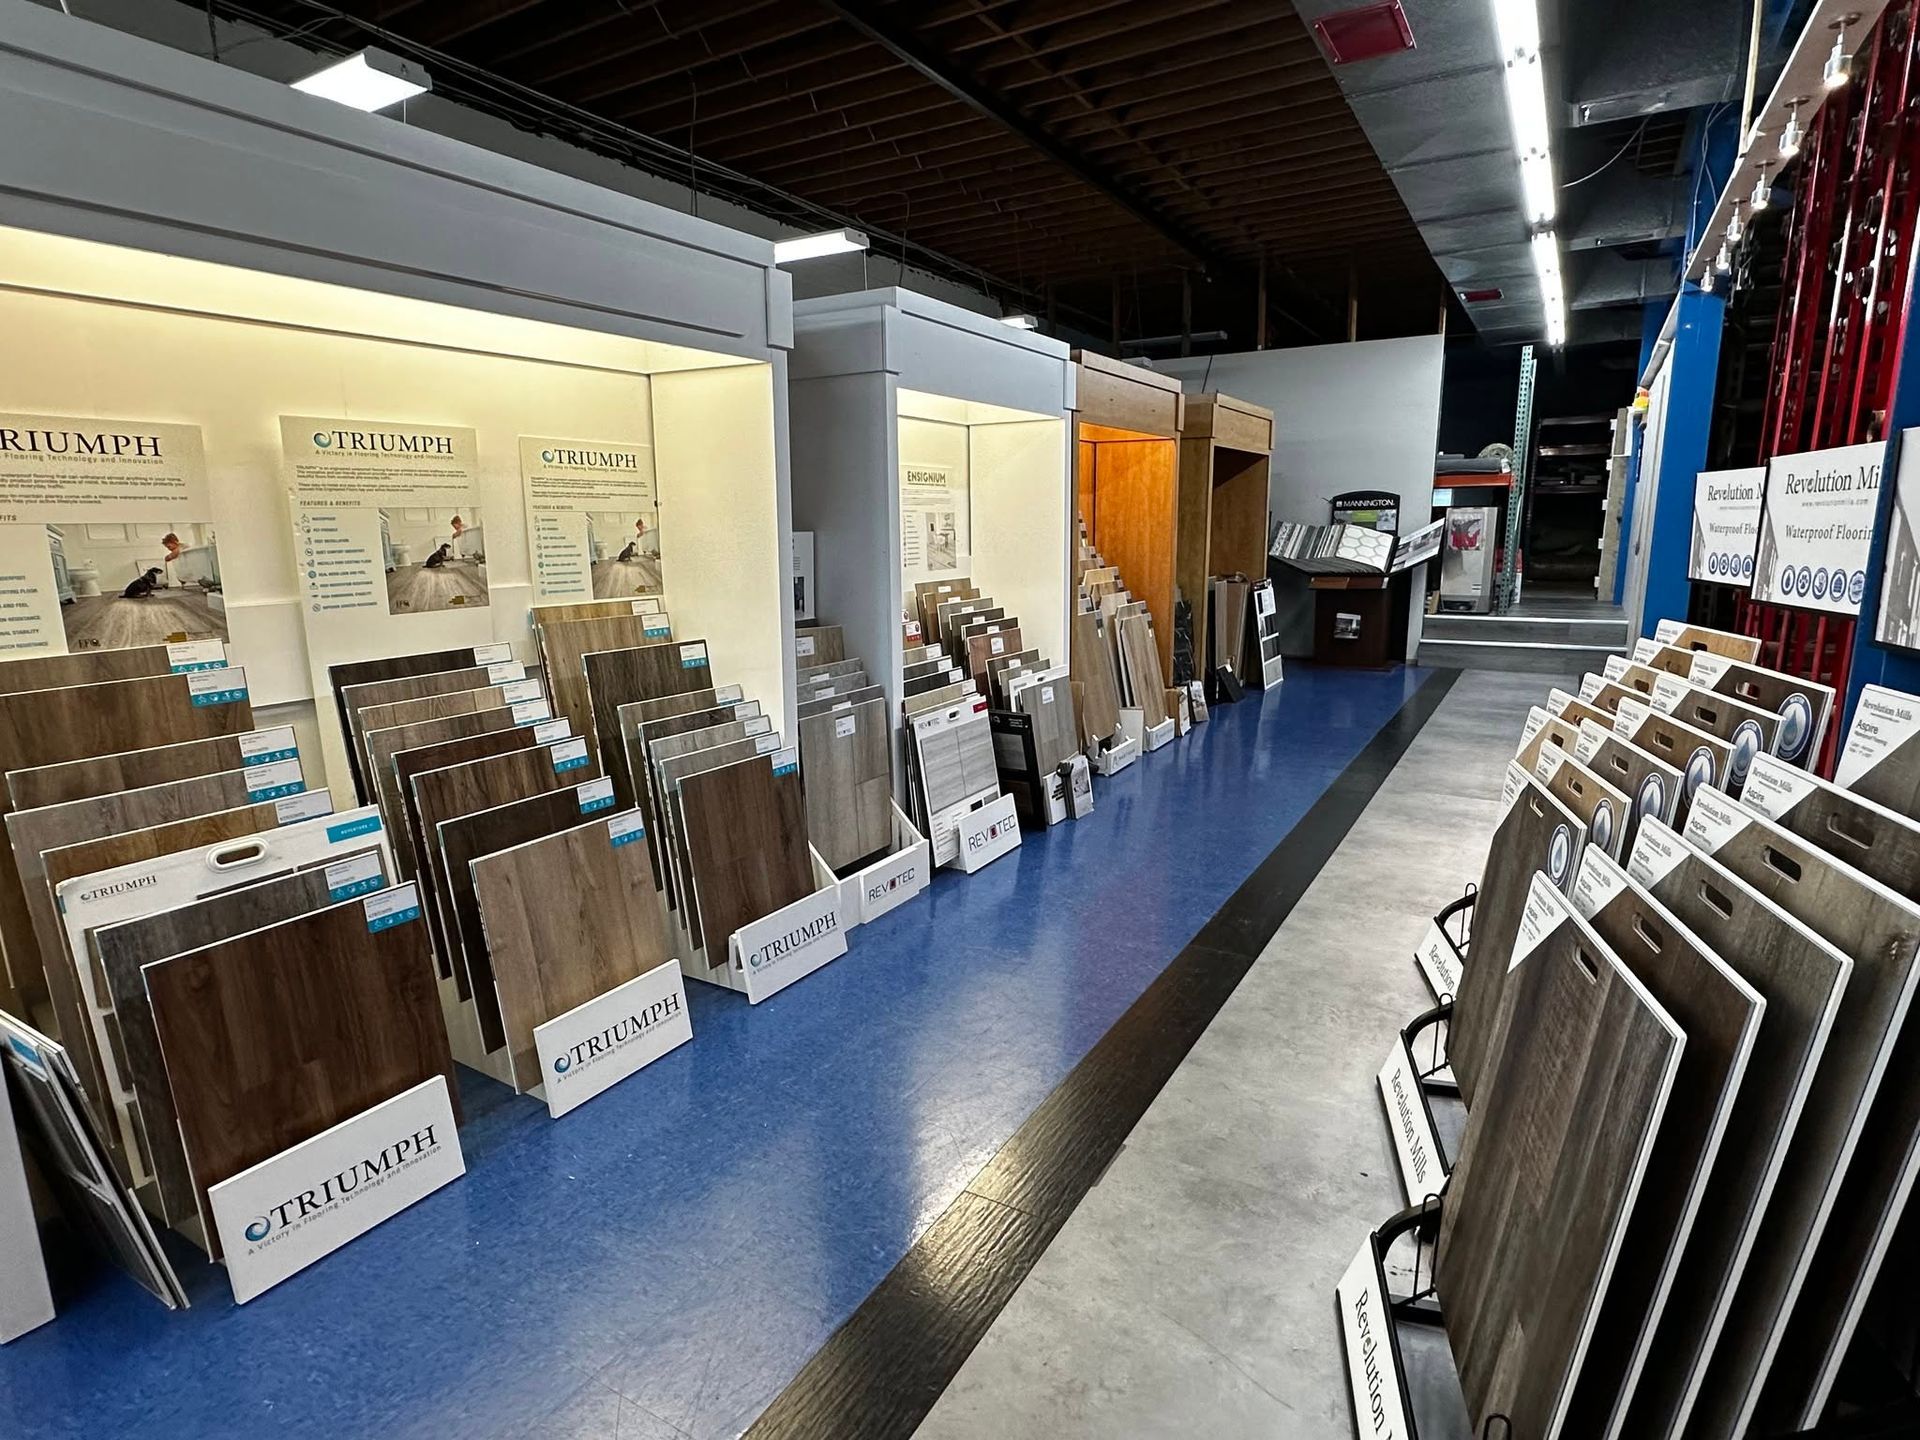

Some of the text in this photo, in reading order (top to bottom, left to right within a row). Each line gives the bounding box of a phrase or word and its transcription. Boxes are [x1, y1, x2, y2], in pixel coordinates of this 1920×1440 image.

[332, 430, 454, 454] TRIUMPH
[4, 452, 44, 462] Flooring
[47, 454, 97, 464] Technology
[119, 457, 164, 465] Innovation
[554, 449, 637, 468] TRIUMPH
[907, 471, 946, 483] ENSIGNIUM
[1785, 470, 1851, 494] Revolution
[1707, 484, 1753, 501] Revolution
[1709, 523, 1743, 536] Waterproof
[1785, 524, 1834, 543] Waterproof
[1863, 699, 1912, 721] Revolution Mills
[1856, 719, 1879, 735] Aspire
[1746, 786, 1765, 803] Aspire
[90, 875, 157, 899] TRIUMPH
[761, 911, 837, 962] TRIUMPH
[1429, 944, 1455, 991] Revolution
[570, 992, 681, 1066] TRIUMPH
[1391, 1067, 1427, 1184] Revolution Mills
[270, 1124, 438, 1229] TRIUMPH
[248, 1145, 442, 1256] A Victory in Flooring Technology and Innovation
[1356, 1286, 1385, 1435] Revolution
